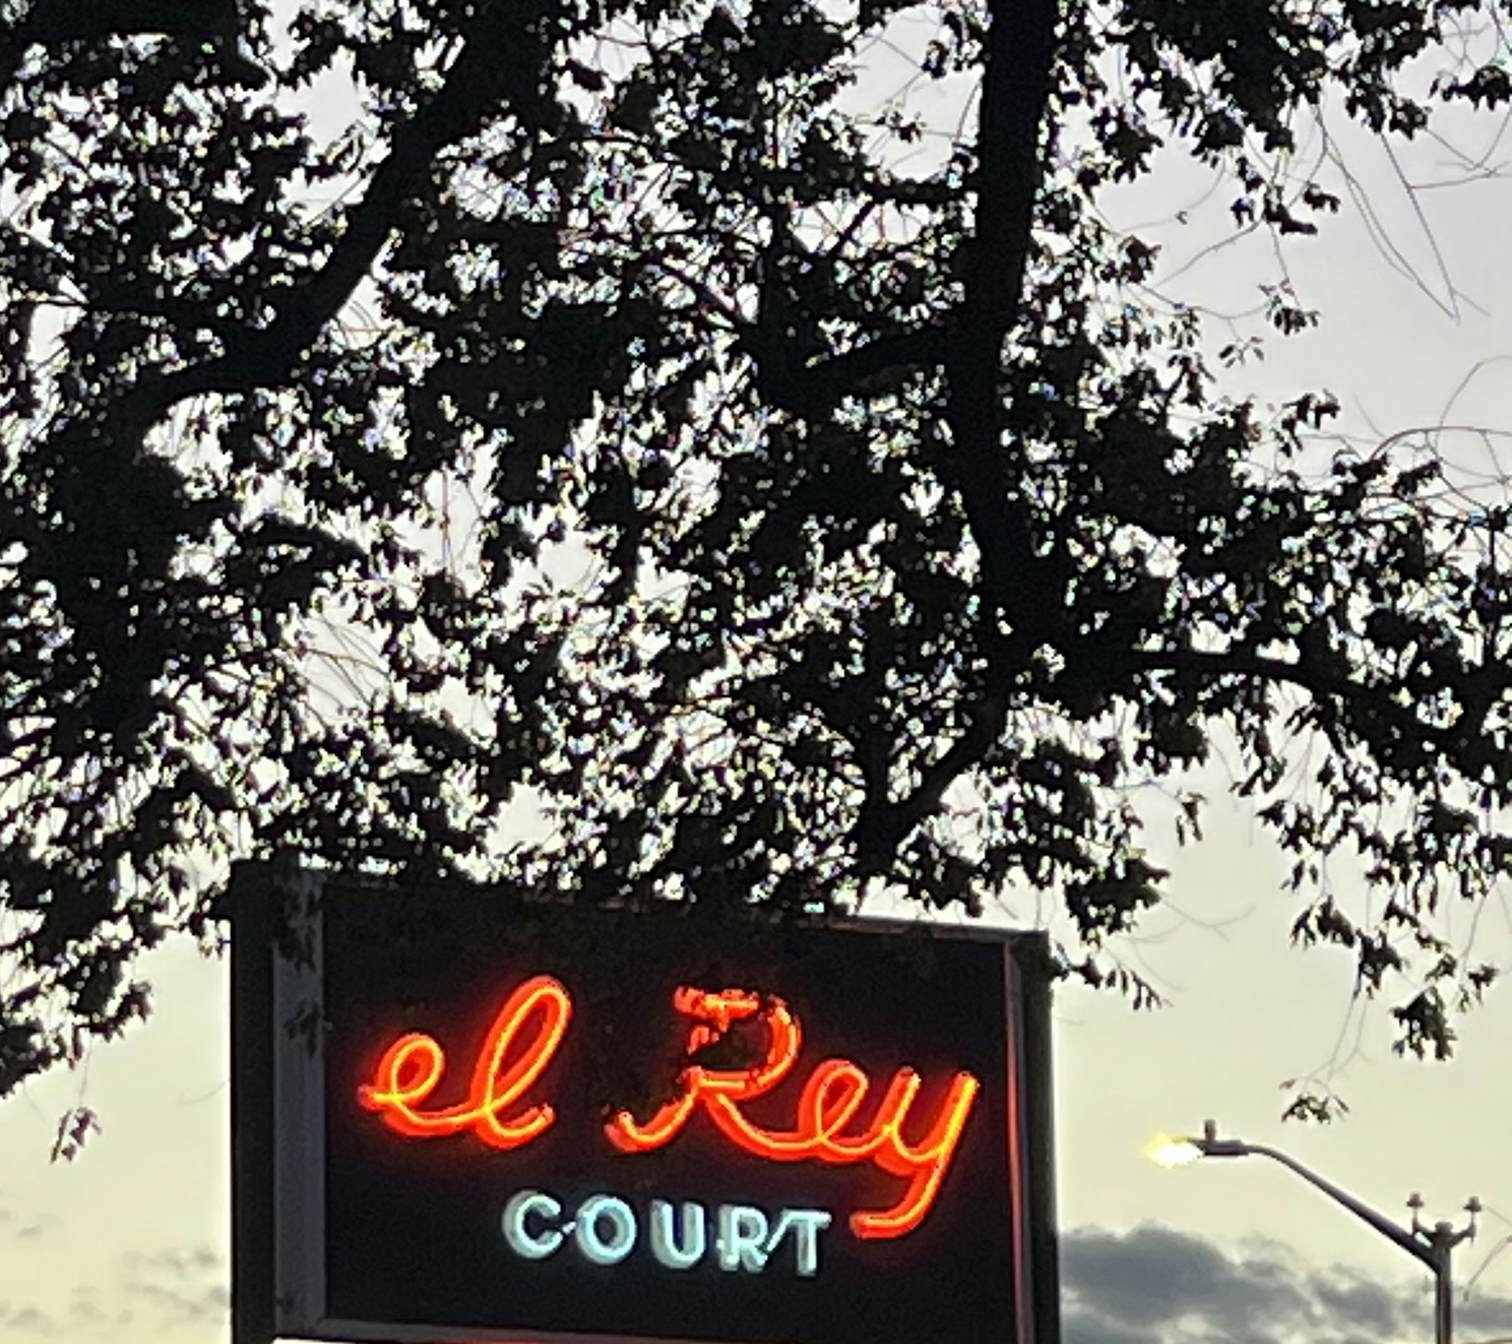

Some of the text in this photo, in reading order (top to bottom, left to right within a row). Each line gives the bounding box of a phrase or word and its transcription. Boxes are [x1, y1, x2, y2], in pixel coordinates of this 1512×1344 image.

[358, 974, 981, 1240] el Rey
[501, 1189, 833, 1277] COURT
